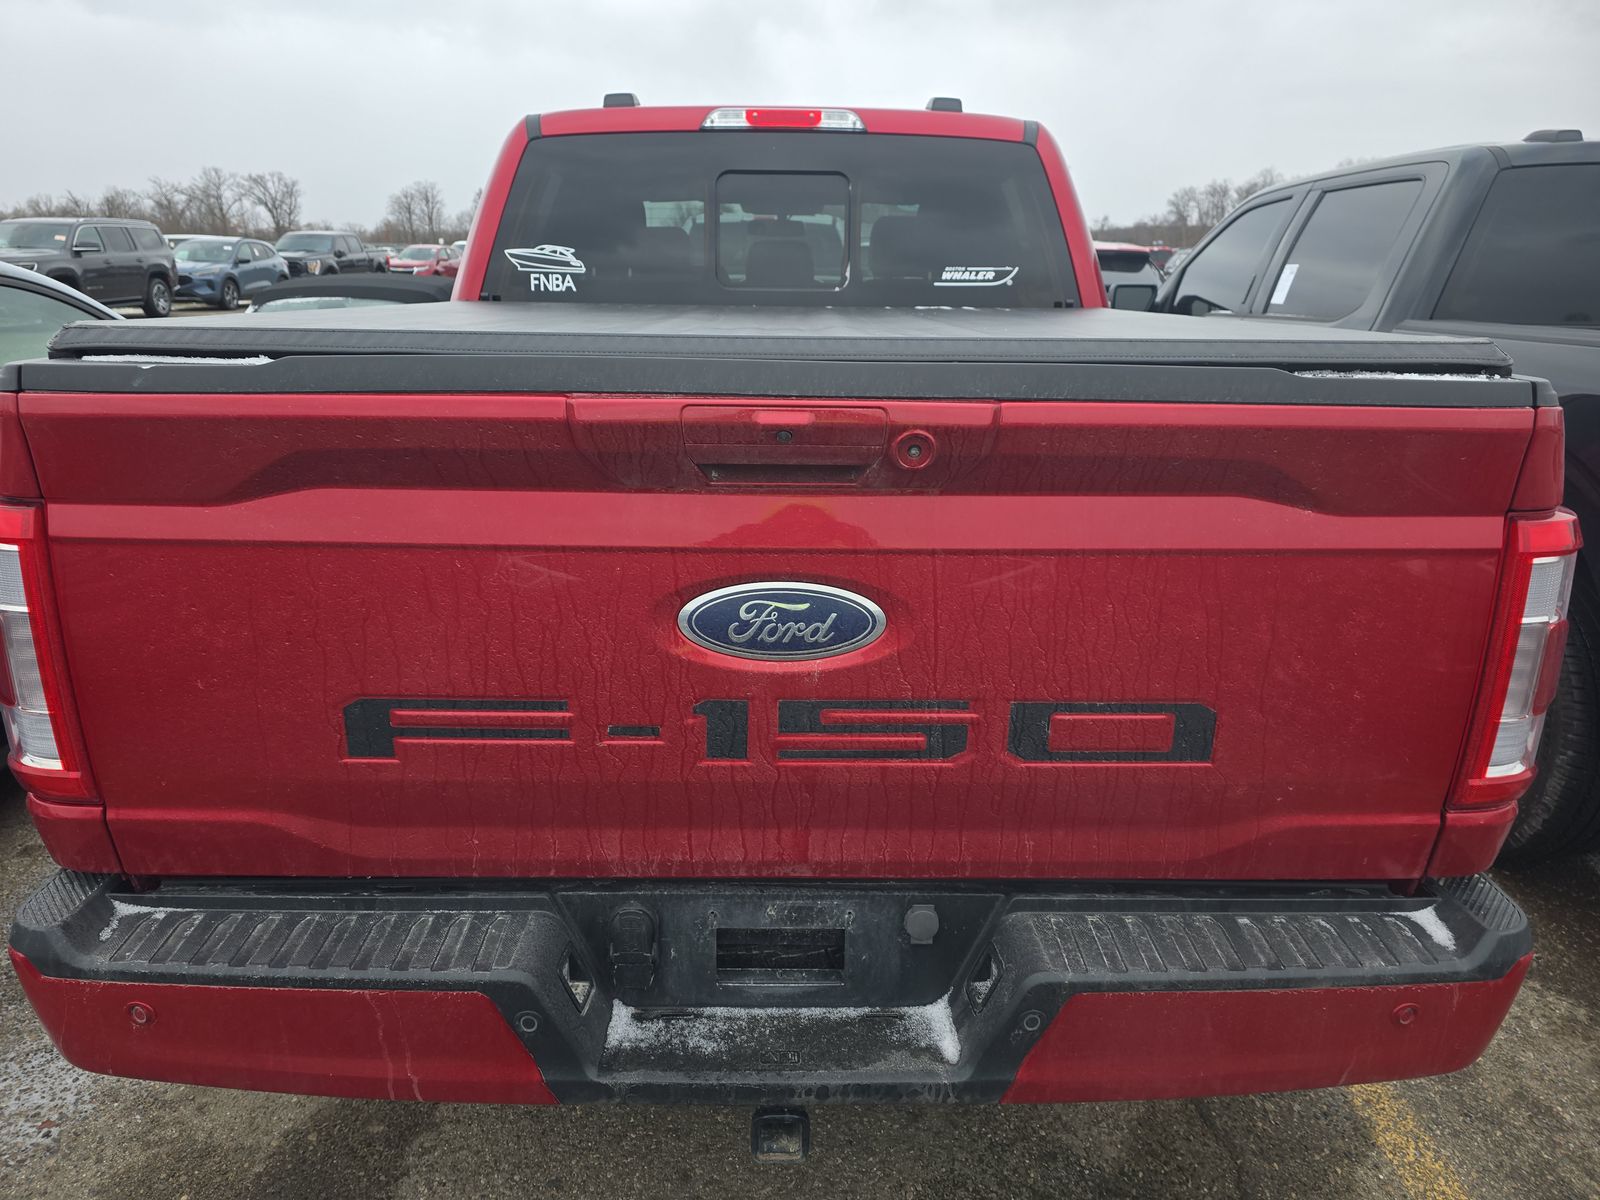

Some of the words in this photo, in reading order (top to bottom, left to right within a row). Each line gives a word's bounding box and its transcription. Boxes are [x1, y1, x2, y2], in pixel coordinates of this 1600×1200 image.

[530, 273, 577, 292] FNBA
[941, 271, 996, 280] WHALER
[728, 600, 838, 643] Ford
[342, 699, 1217, 763] F-150
